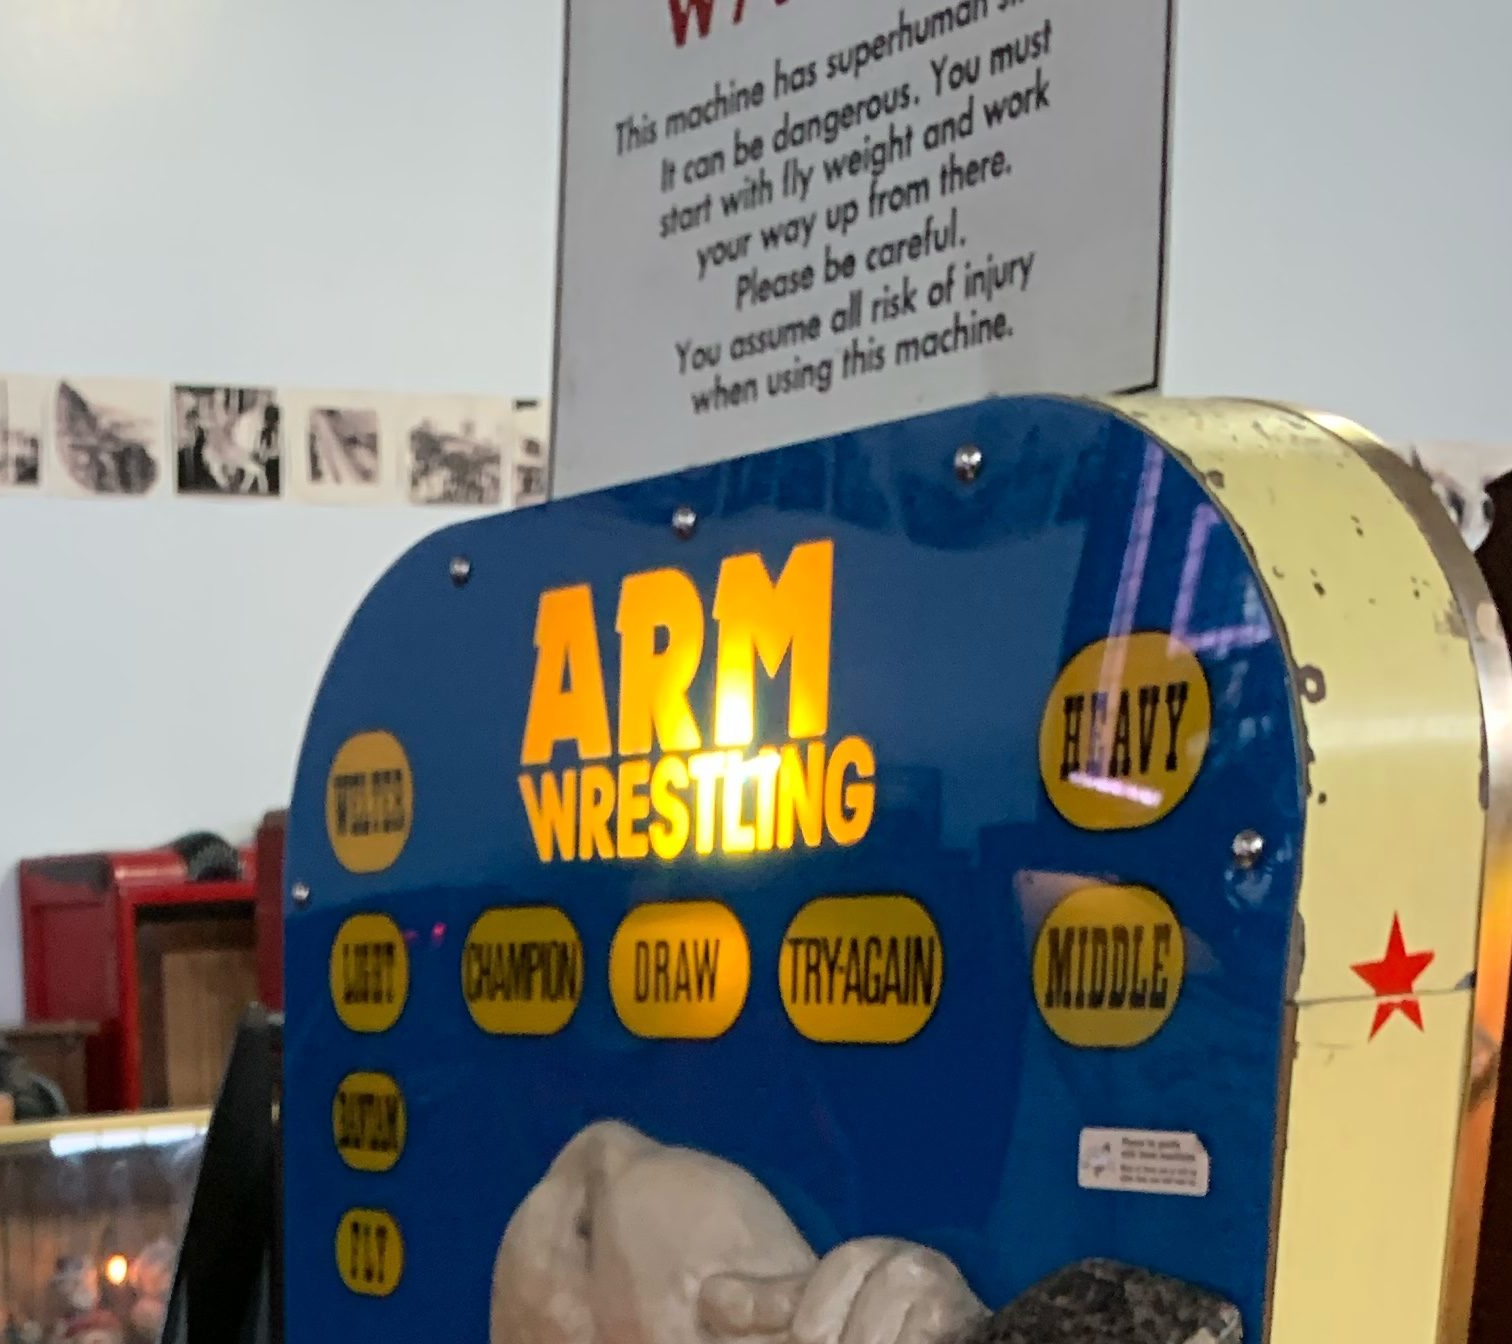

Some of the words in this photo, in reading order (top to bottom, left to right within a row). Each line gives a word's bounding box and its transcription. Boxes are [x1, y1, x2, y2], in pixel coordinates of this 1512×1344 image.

[616, 113, 658, 156] This
[665, 78, 764, 139] machine
[773, 57, 817, 99] has
[826, 0, 988, 80] superhuman
[660, 156, 675, 193] It
[684, 150, 725, 184] can
[733, 128, 764, 167] be
[772, 82, 920, 153] dangerous.
[930, 54, 981, 97] You
[990, 18, 1052, 76] must
[660, 194, 712, 239] start
[721, 166, 773, 218] with
[782, 157, 815, 201] fly
[823, 121, 913, 184] weight
[923, 93, 975, 151] and
[983, 66, 1050, 129] work
[697, 232, 752, 281] your
[761, 211, 817, 249] way
[826, 199, 859, 237] up
[869, 176, 930, 219] from
[940, 150, 1012, 196] there.
[736, 265, 814, 312] Please
[824, 243, 856, 284] be
[865, 206, 966, 273] careful.
[675, 338, 722, 375] You
[730, 314, 821, 361] assume
[830, 289, 863, 334] all
[871, 275, 917, 324] risk
[927, 262, 955, 308] of
[964, 252, 1036, 302] injury
[691, 374, 758, 415] when
[767, 355, 833, 396] using
[842, 336, 885, 379] this
[895, 309, 1014, 366] machine.
[519, 537, 835, 766] ARM
[1059, 681, 1189, 781] HEAVY
[517, 734, 877, 864] WRESTLING
[465, 939, 580, 1002] CHAMPION
[634, 938, 721, 1003] DRAW
[1044, 922, 1172, 1010] MIDDLE
